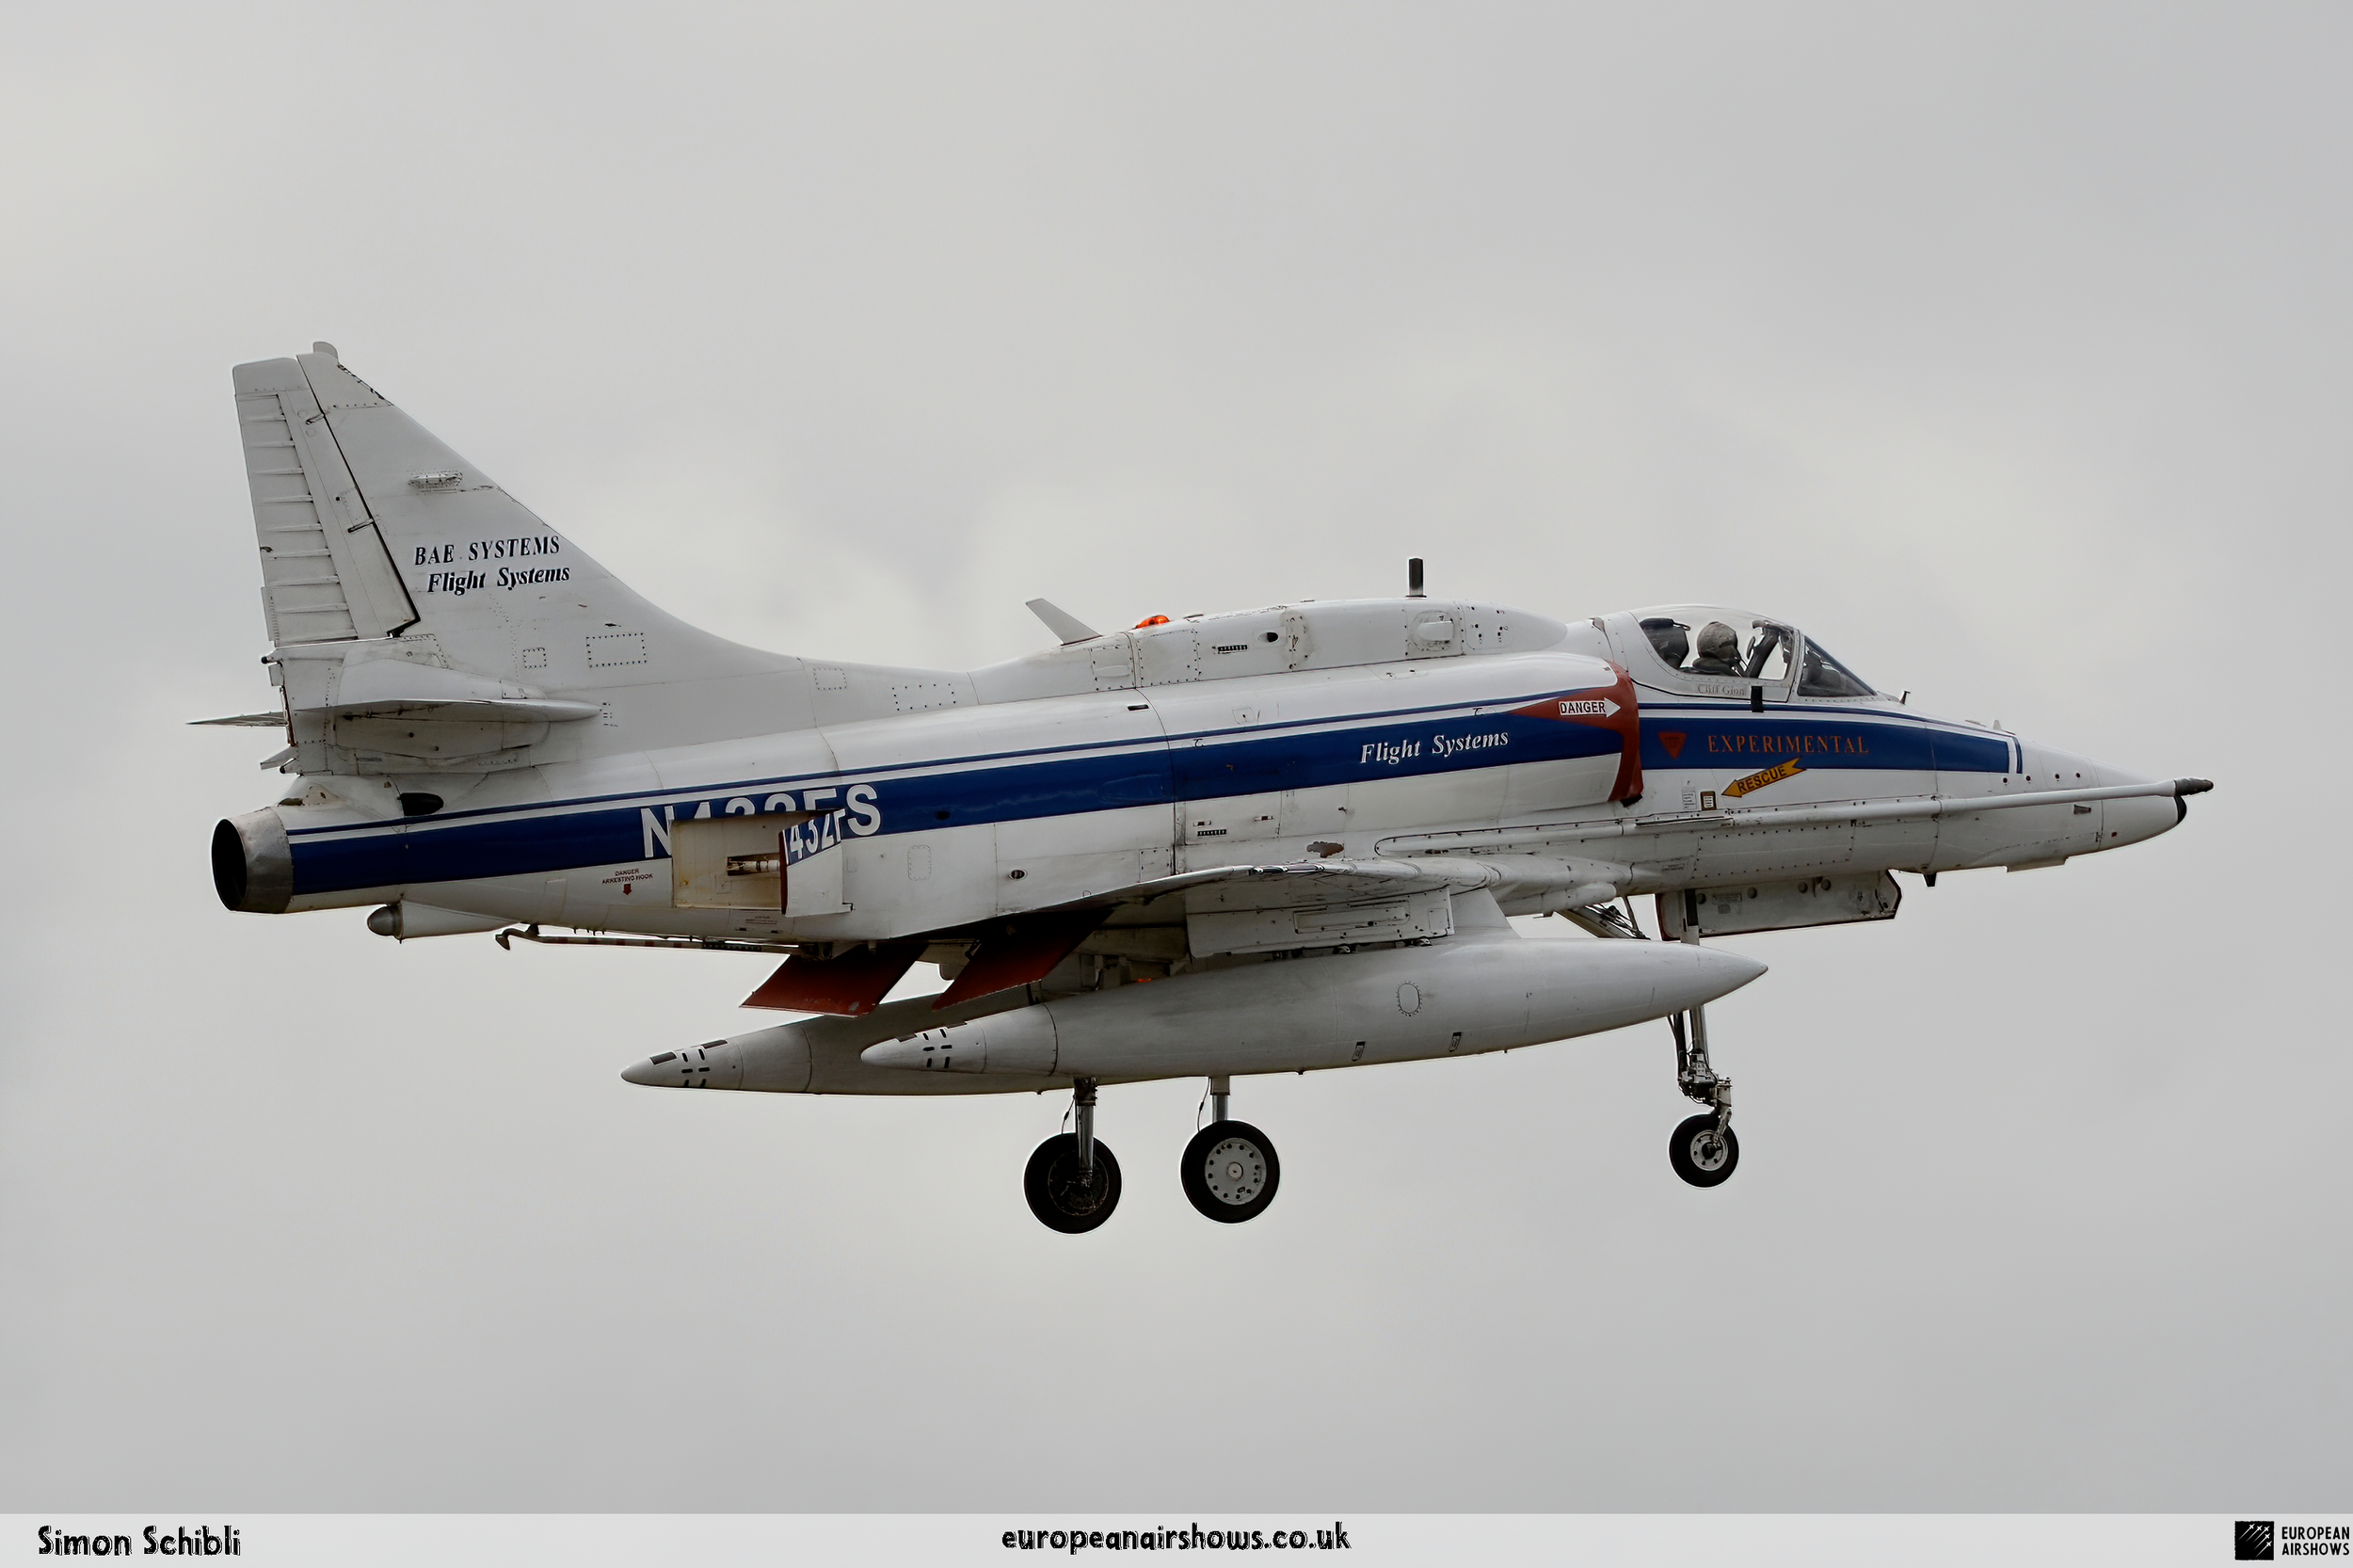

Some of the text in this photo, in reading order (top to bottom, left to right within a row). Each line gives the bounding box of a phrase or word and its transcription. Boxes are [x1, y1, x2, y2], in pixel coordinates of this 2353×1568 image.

[415, 536, 560, 566] BAE SYSTEMS
[427, 567, 569, 596] Flight Systems
[1560, 701, 1606, 713] DANGER
[1360, 731, 1509, 764] Flight Systems
[1707, 734, 1869, 753] EXPERIMENTAL
[1737, 765, 1787, 792] RESCUE
